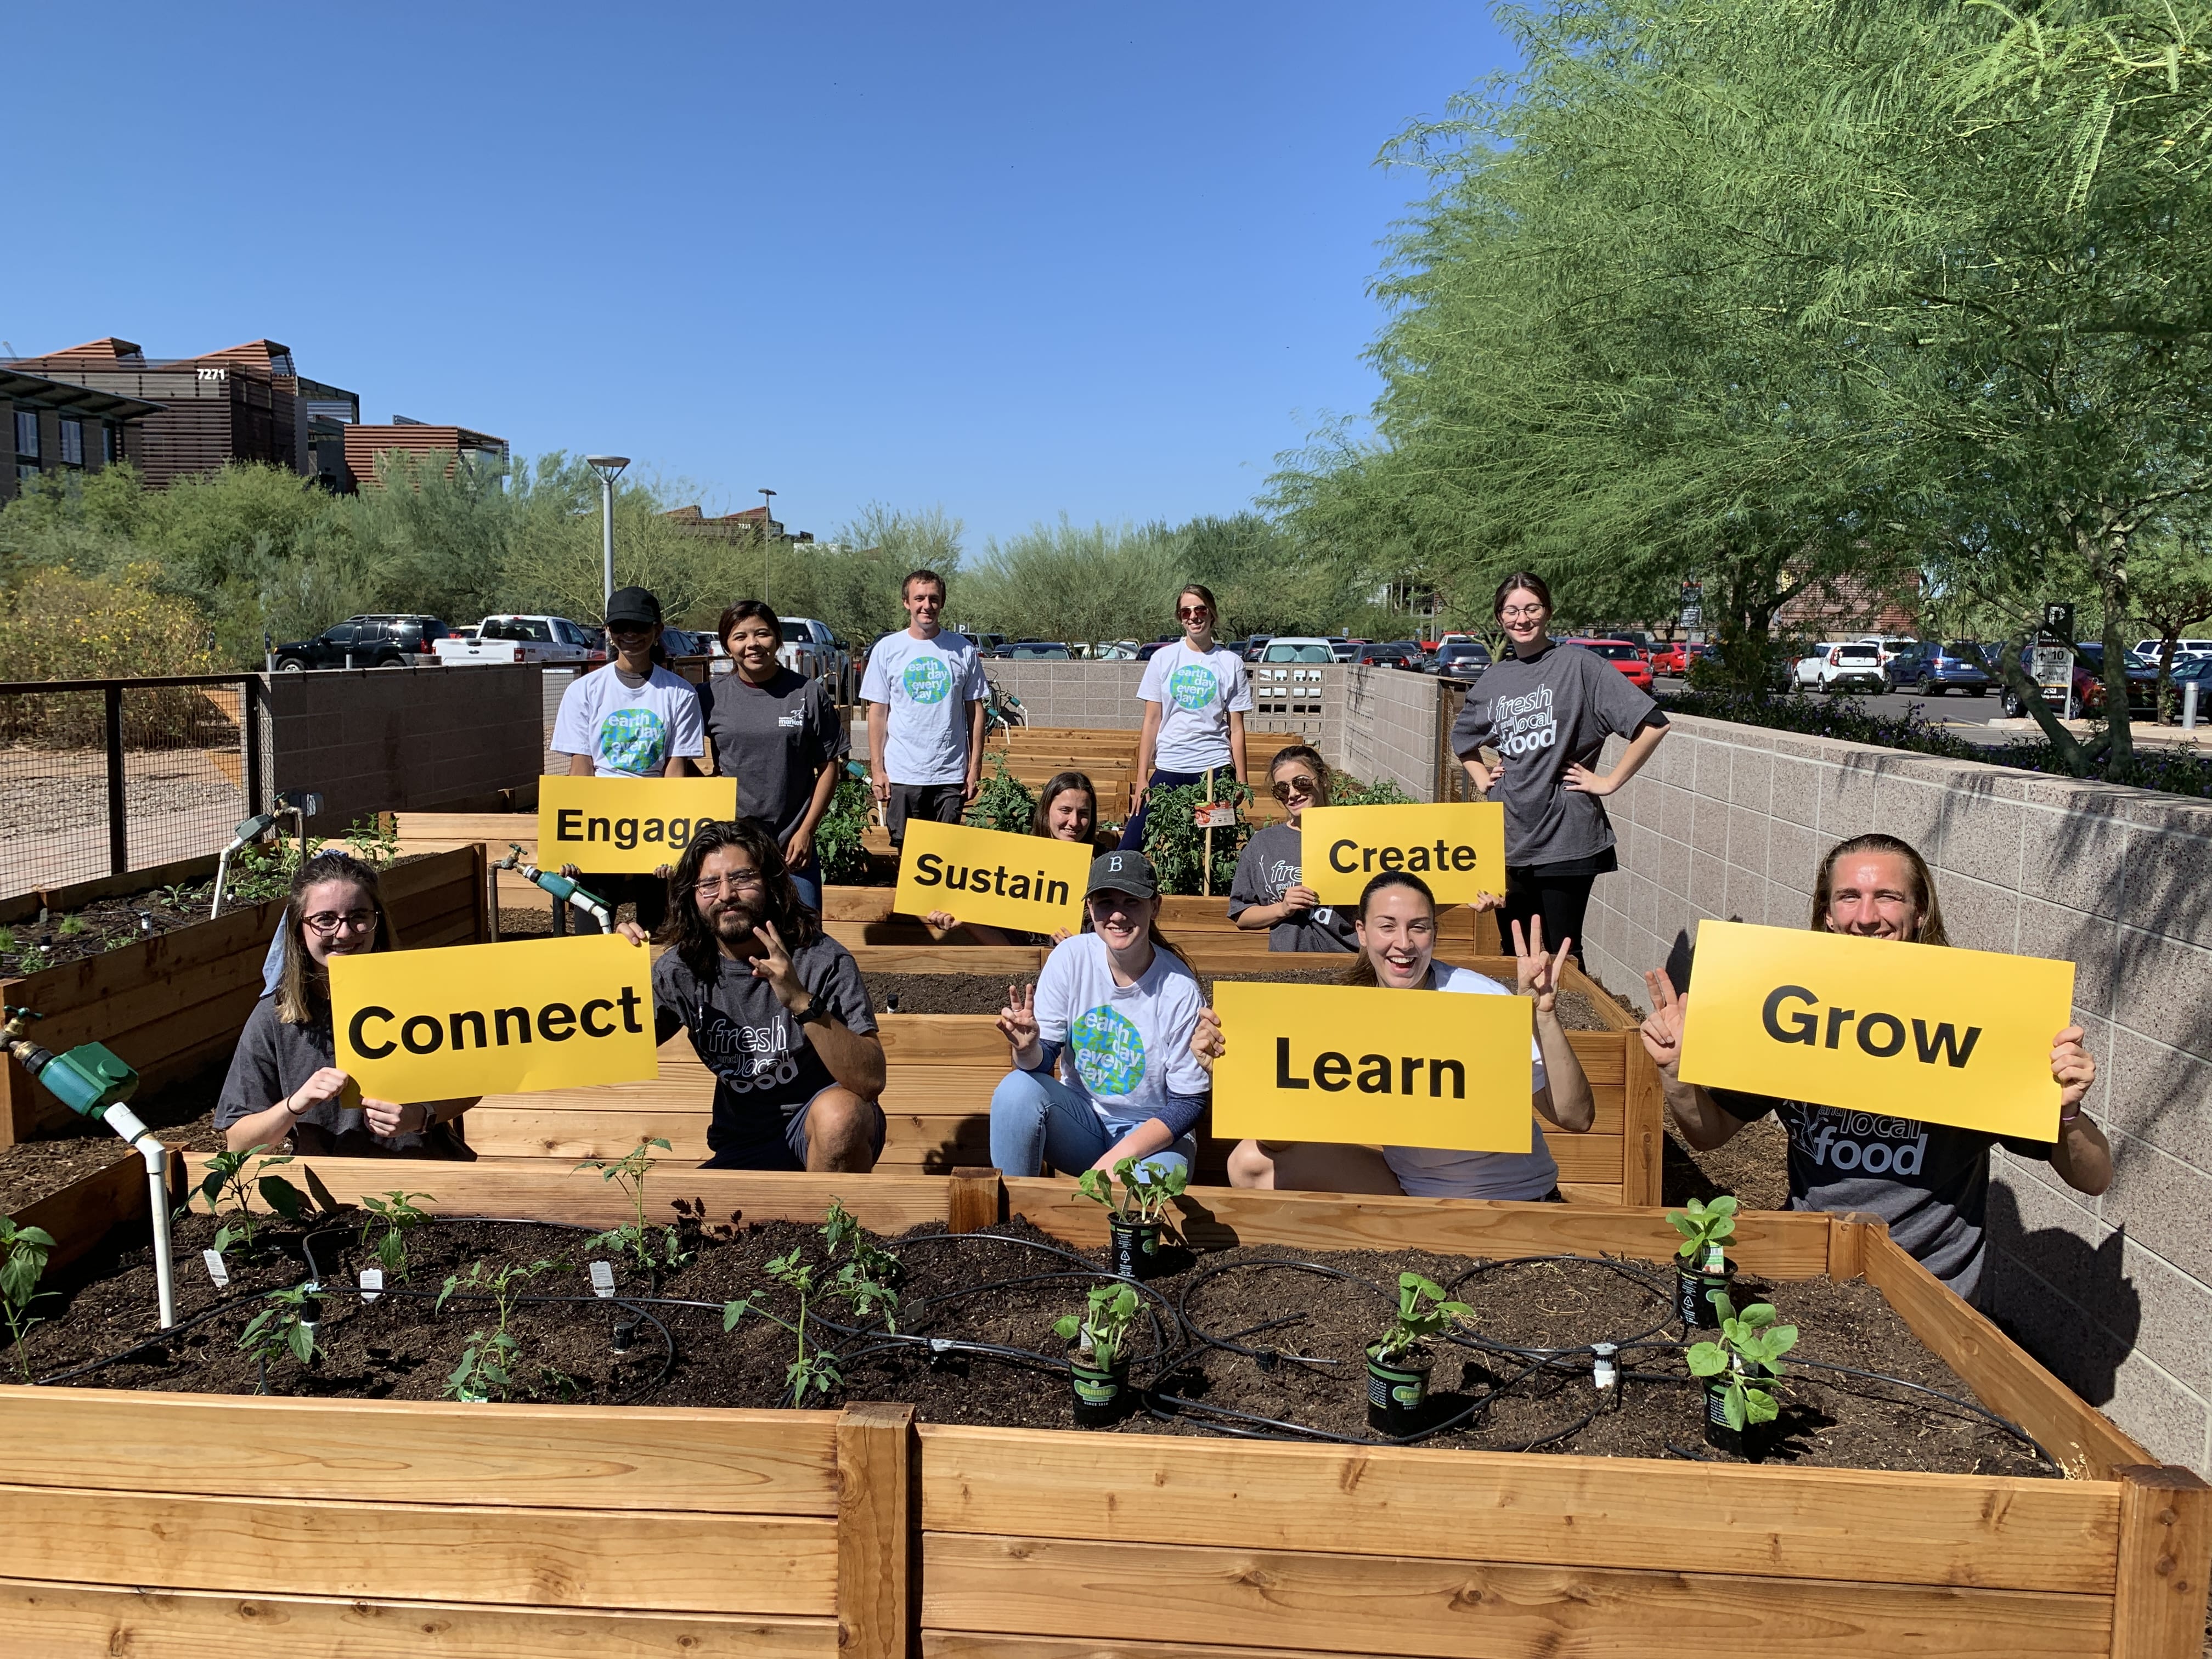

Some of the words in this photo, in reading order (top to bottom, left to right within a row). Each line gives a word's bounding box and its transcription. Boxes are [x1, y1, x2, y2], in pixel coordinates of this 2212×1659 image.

[196, 368, 225, 380] 7271
[2049, 606, 2066, 625] P
[959, 624, 966, 633] P
[2052, 651, 2064, 660] 10
[908, 660, 938, 672] earth
[1178, 669, 1207, 678] earth
[927, 669, 947, 681] day
[1194, 675, 1215, 690] day
[912, 680, 943, 690] every
[1177, 685, 1209, 697] every
[912, 687, 932, 700] day
[1176, 692, 1195, 705] day
[1496, 684, 1553, 723] fresh
[608, 713, 650, 727] earth
[1513, 705, 1553, 735] local
[635, 725, 662, 742] day
[611, 741, 654, 754] every
[611, 751, 636, 767] day
[1108, 856, 1123, 872] B
[1329, 839, 1477, 873] Create
[913, 854, 1069, 905] Sustain
[1271, 860, 1302, 883] fre
[348, 986, 643, 1059] Connect
[1762, 985, 1983, 1069] Grow
[707, 1015, 787, 1053] fresh
[1112, 1040, 1142, 1067] day
[1079, 1048, 1128, 1078] every
[1276, 1037, 1465, 1099] Learn
[1075, 1058, 1109, 1086] day
[1840, 1108, 1922, 1139] local
[1814, 1126, 1928, 1175] food
[1079, 1385, 1111, 1396] Bonnie
